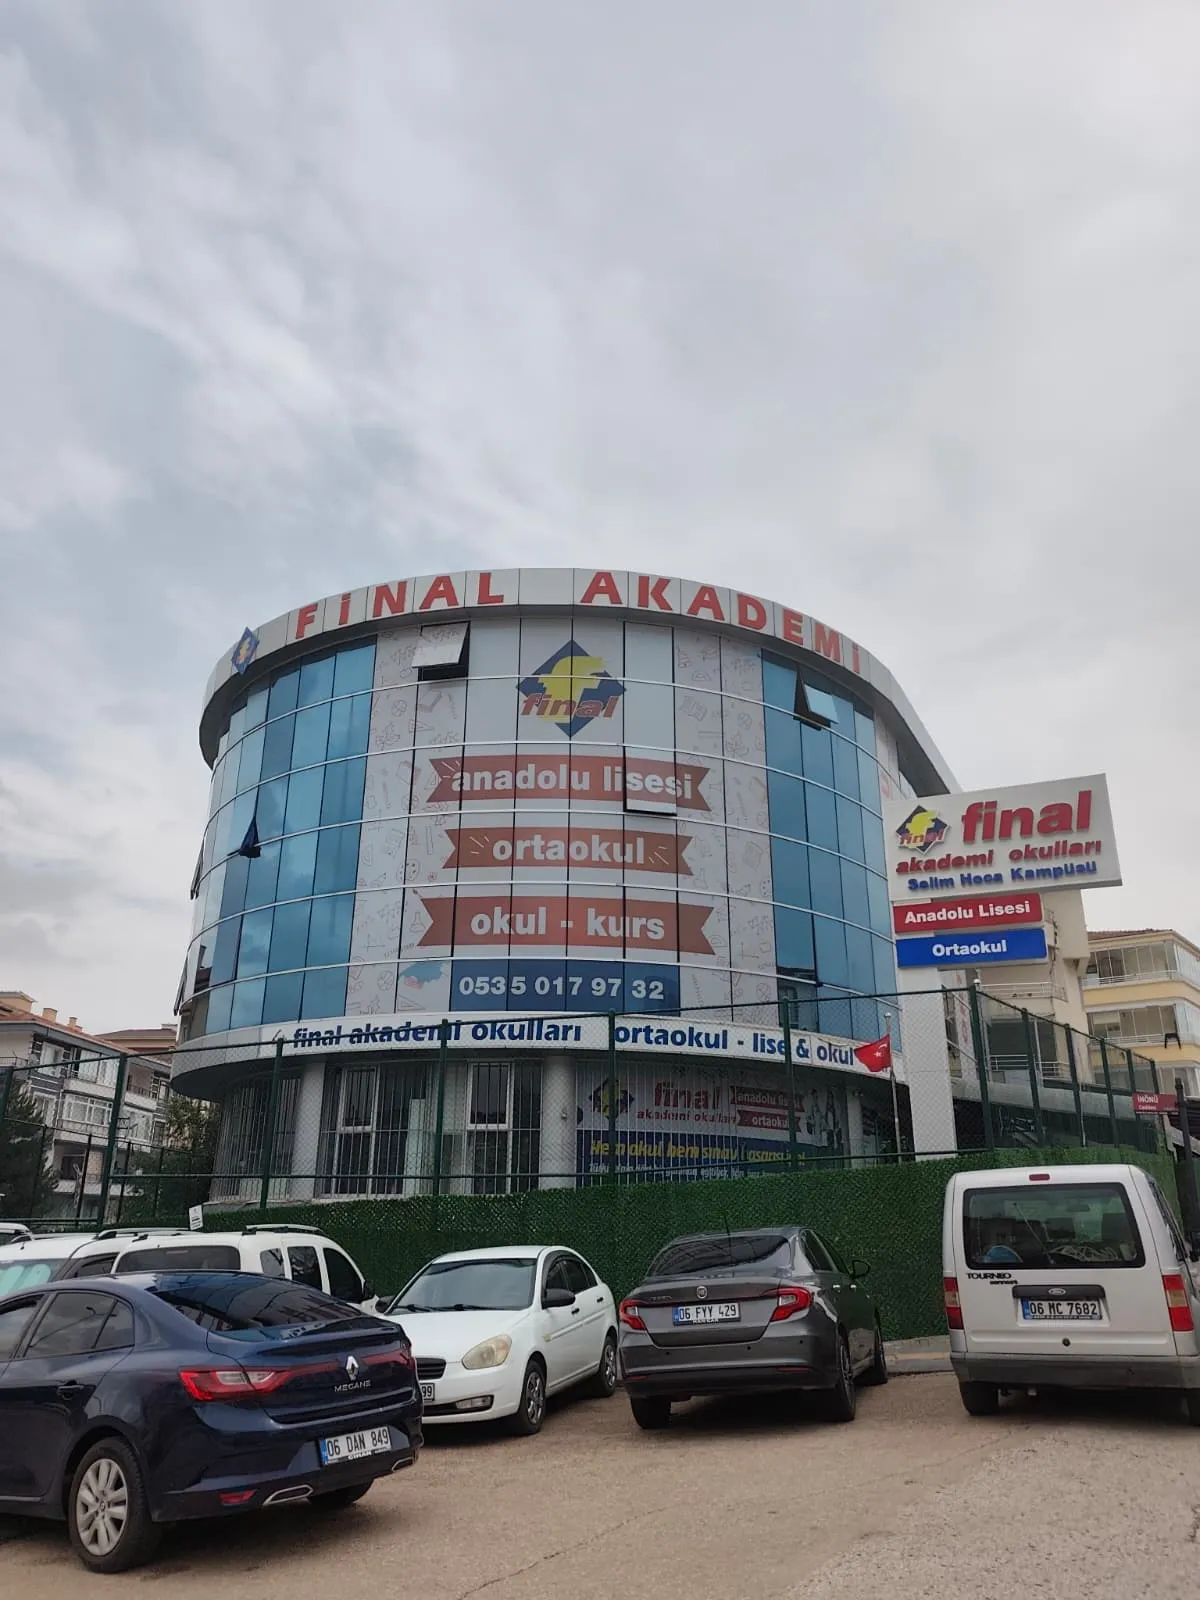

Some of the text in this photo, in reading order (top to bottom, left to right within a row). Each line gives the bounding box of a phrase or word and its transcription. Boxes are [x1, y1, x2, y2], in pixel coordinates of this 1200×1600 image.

[295, 572, 504, 639] FİNAL
[520, 692, 620, 720] final
[451, 763, 692, 799] anadolu lisesi
[962, 789, 1092, 844] final
[492, 834, 644, 864] ortaokul
[896, 840, 1101, 874] akademi okulları
[908, 876, 954, 891] Selim
[961, 872, 1003, 887] Hoca
[471, 906, 547, 936] okul
[587, 907, 665, 940] kurs
[905, 900, 1030, 924] Anadolu Lisesi
[932, 939, 1007, 957] Ortaokul
[459, 976, 664, 999] 0535 017 97 32
[293, 1018, 582, 1049] final akademi okulları
[614, 1025, 728, 1050] ortaokul
[752, 1032, 792, 1056] lise
[796, 1042, 810, 1058] &
[817, 1046, 854, 1065] okul
[752, 1114, 789, 1128] ortaoku
[966, 1272, 1012, 1280] TOURNEO
[679, 1304, 737, 1320] 06 FYY 429
[1030, 1302, 1044, 1315] 06
[1067, 1302, 1098, 1315] 7682
[334, 1380, 371, 1392] MEGANE
[327, 1428, 389, 1457] 06 DAN 849
